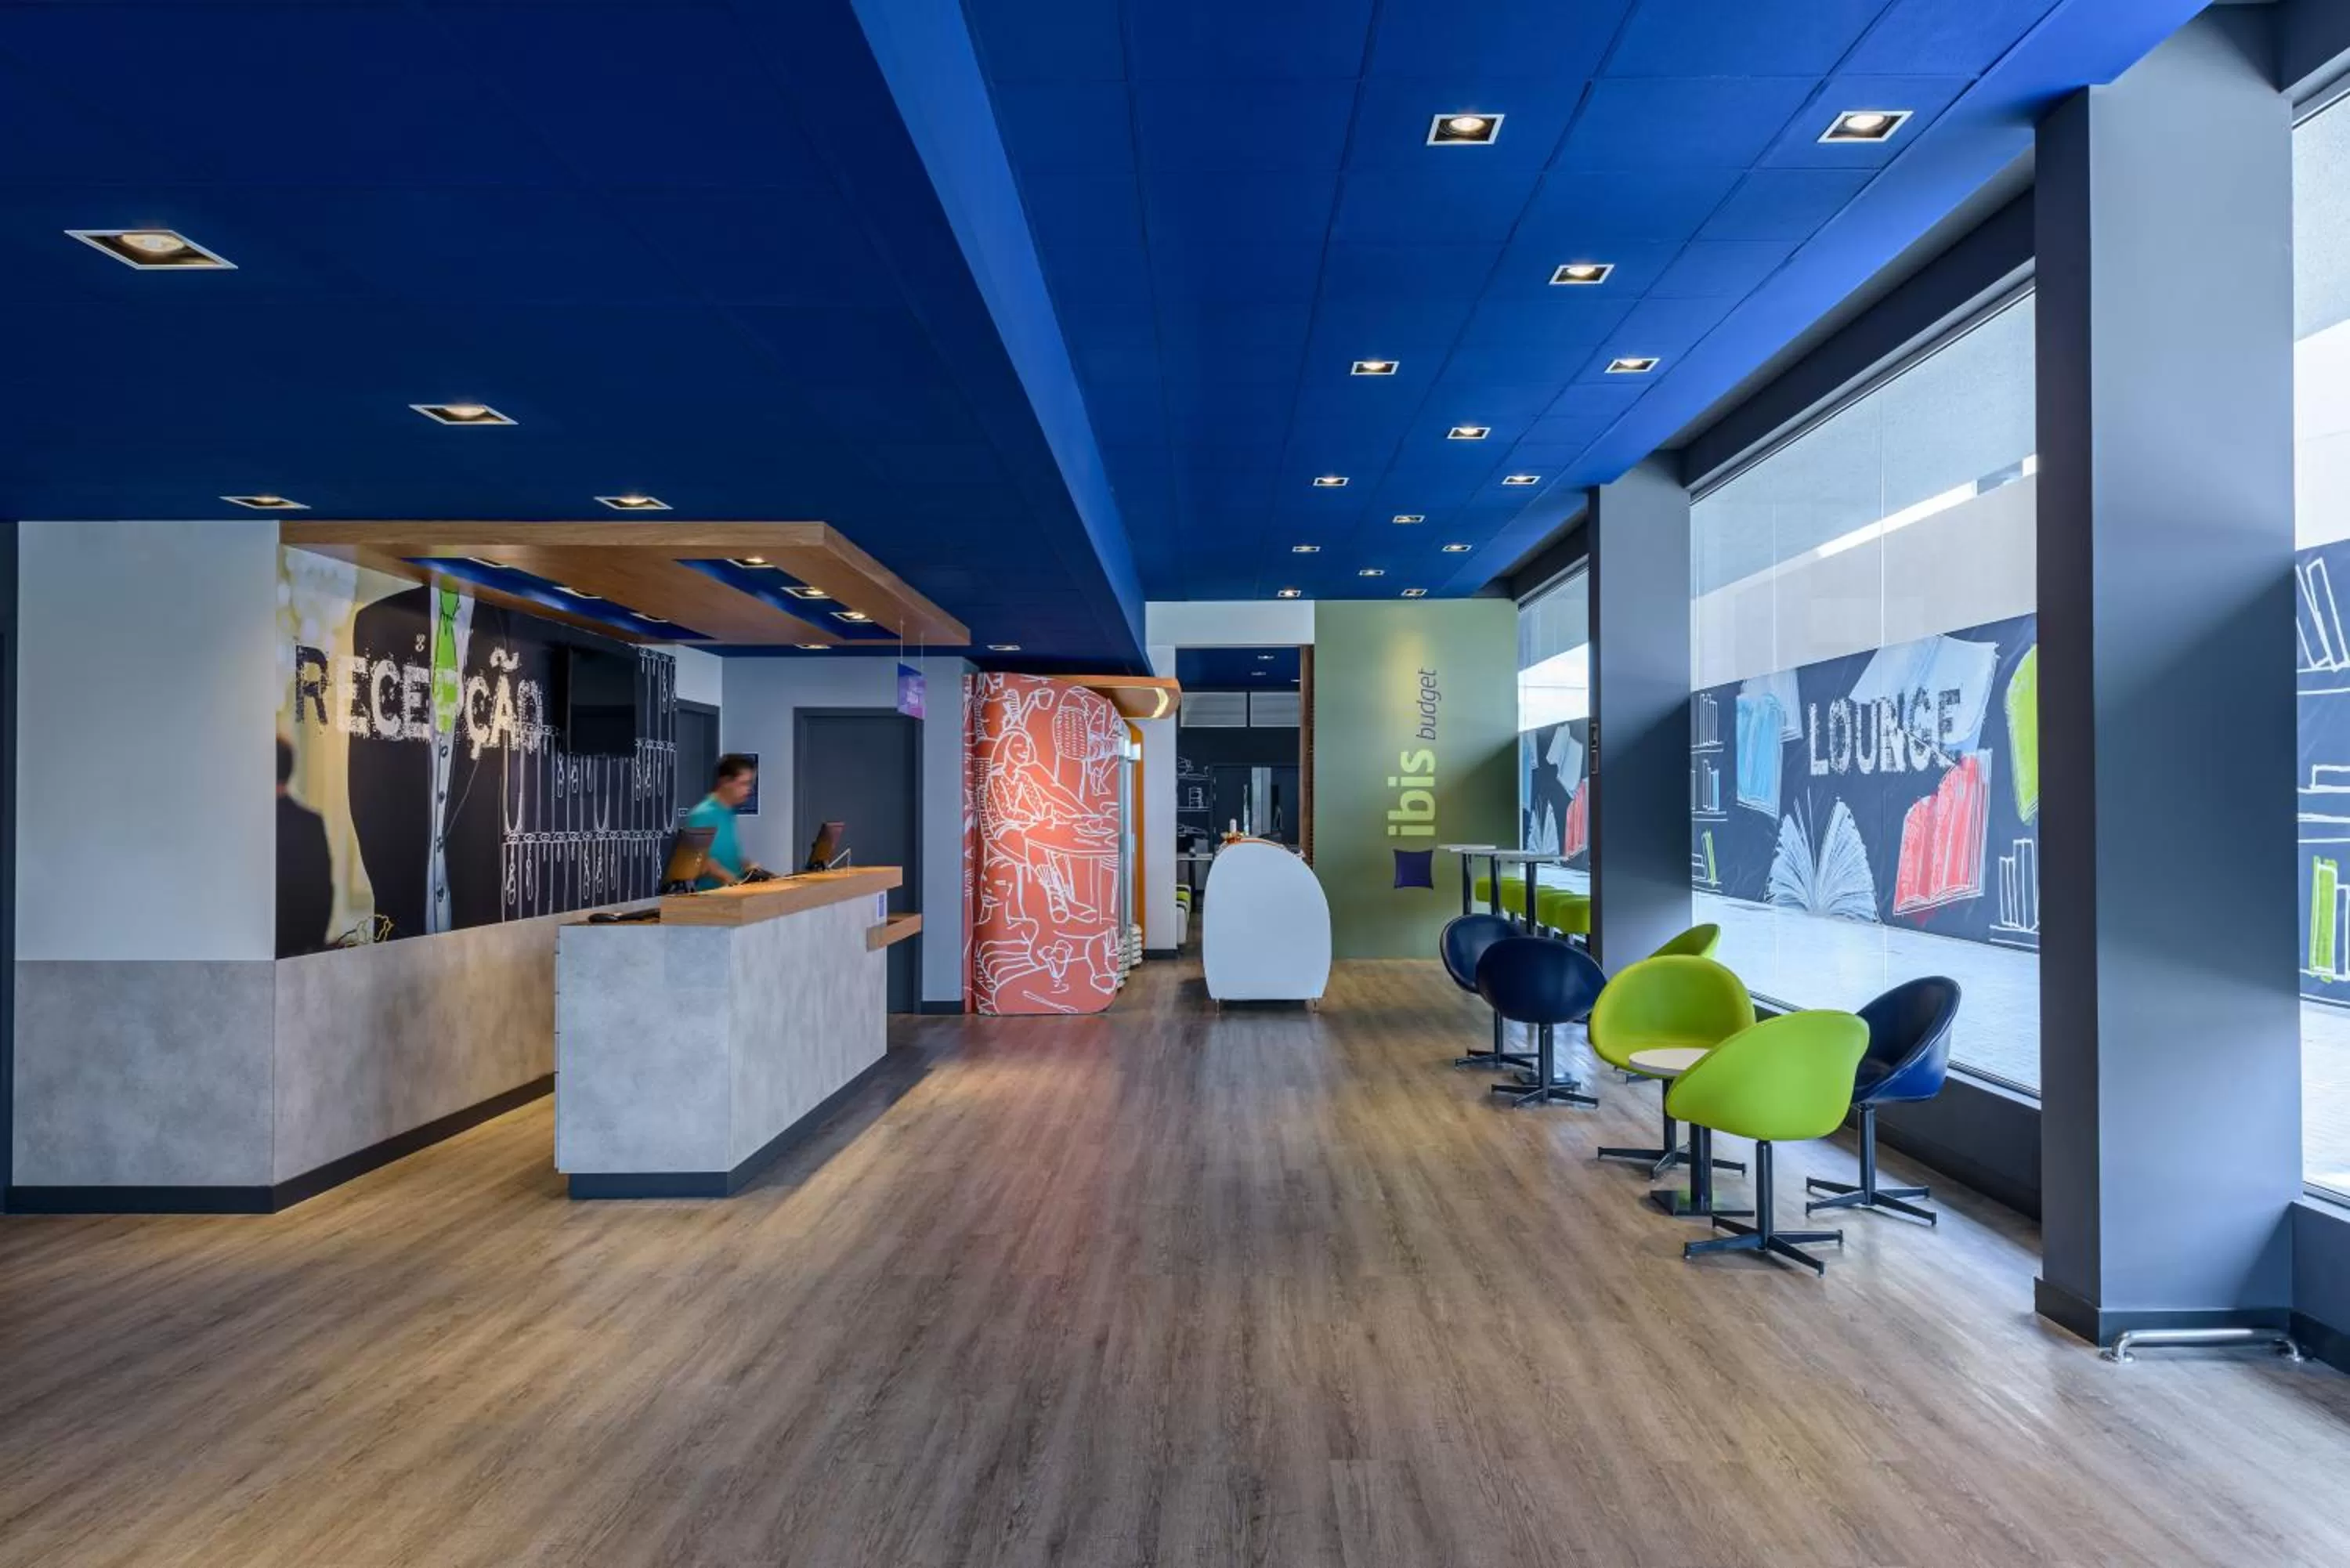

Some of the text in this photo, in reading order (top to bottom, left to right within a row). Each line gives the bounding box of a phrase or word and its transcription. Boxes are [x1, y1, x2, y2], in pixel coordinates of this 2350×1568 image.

[1387, 667, 1441, 836] ibis budget
[1809, 687, 1961, 776] LOUNGE
